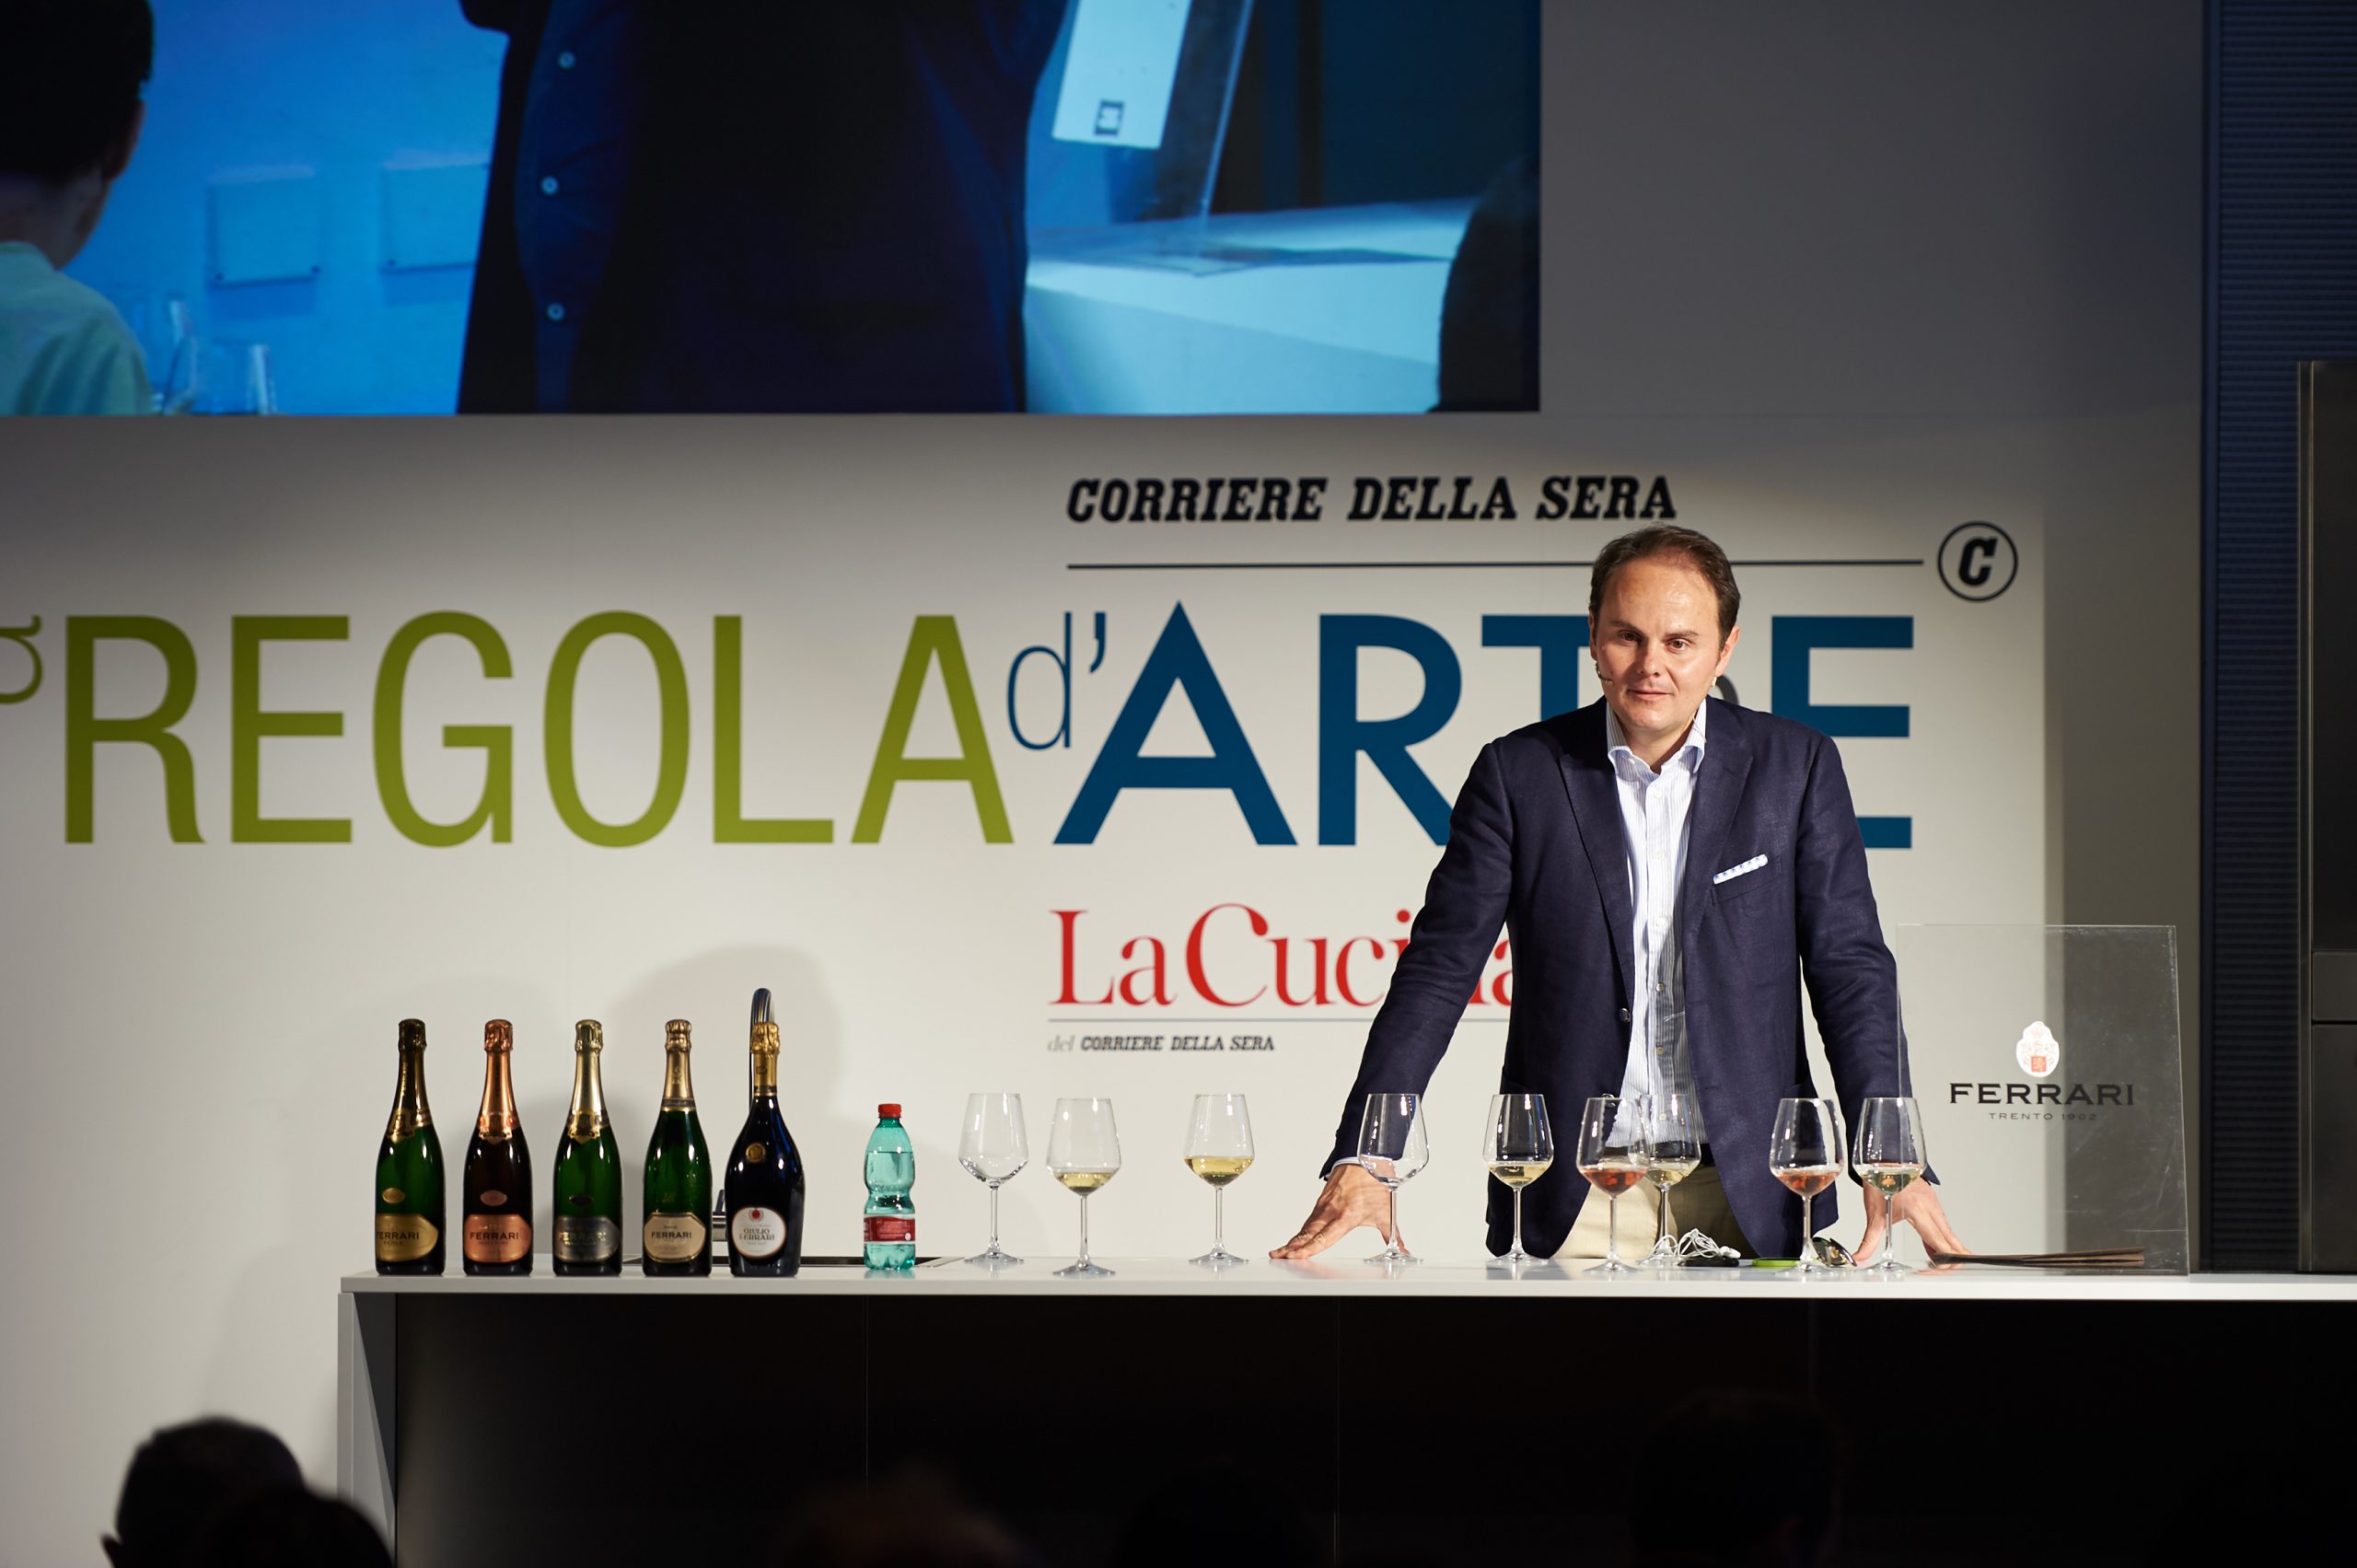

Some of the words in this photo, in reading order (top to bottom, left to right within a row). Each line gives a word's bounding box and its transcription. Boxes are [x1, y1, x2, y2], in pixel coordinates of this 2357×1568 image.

[1067, 478, 1328, 522] CORRIERE
[1347, 476, 1516, 521] DELLA
[1535, 474, 1677, 520] SERA
[65, 610, 1014, 849] REGOLA
[1185, 902, 1513, 1006] Cuc
[1047, 1035, 1075, 1051] del
[1080, 1035, 1165, 1051] CORRIERE
[1170, 1035, 1225, 1051] DELLA
[1229, 1035, 1275, 1051] SERA
[1949, 1083, 2134, 1106] FERRARI
[1989, 1112, 2053, 1121] TRENTO
[2061, 1112, 2097, 1121] 1902
[470, 1231, 519, 1240] FERRARI
